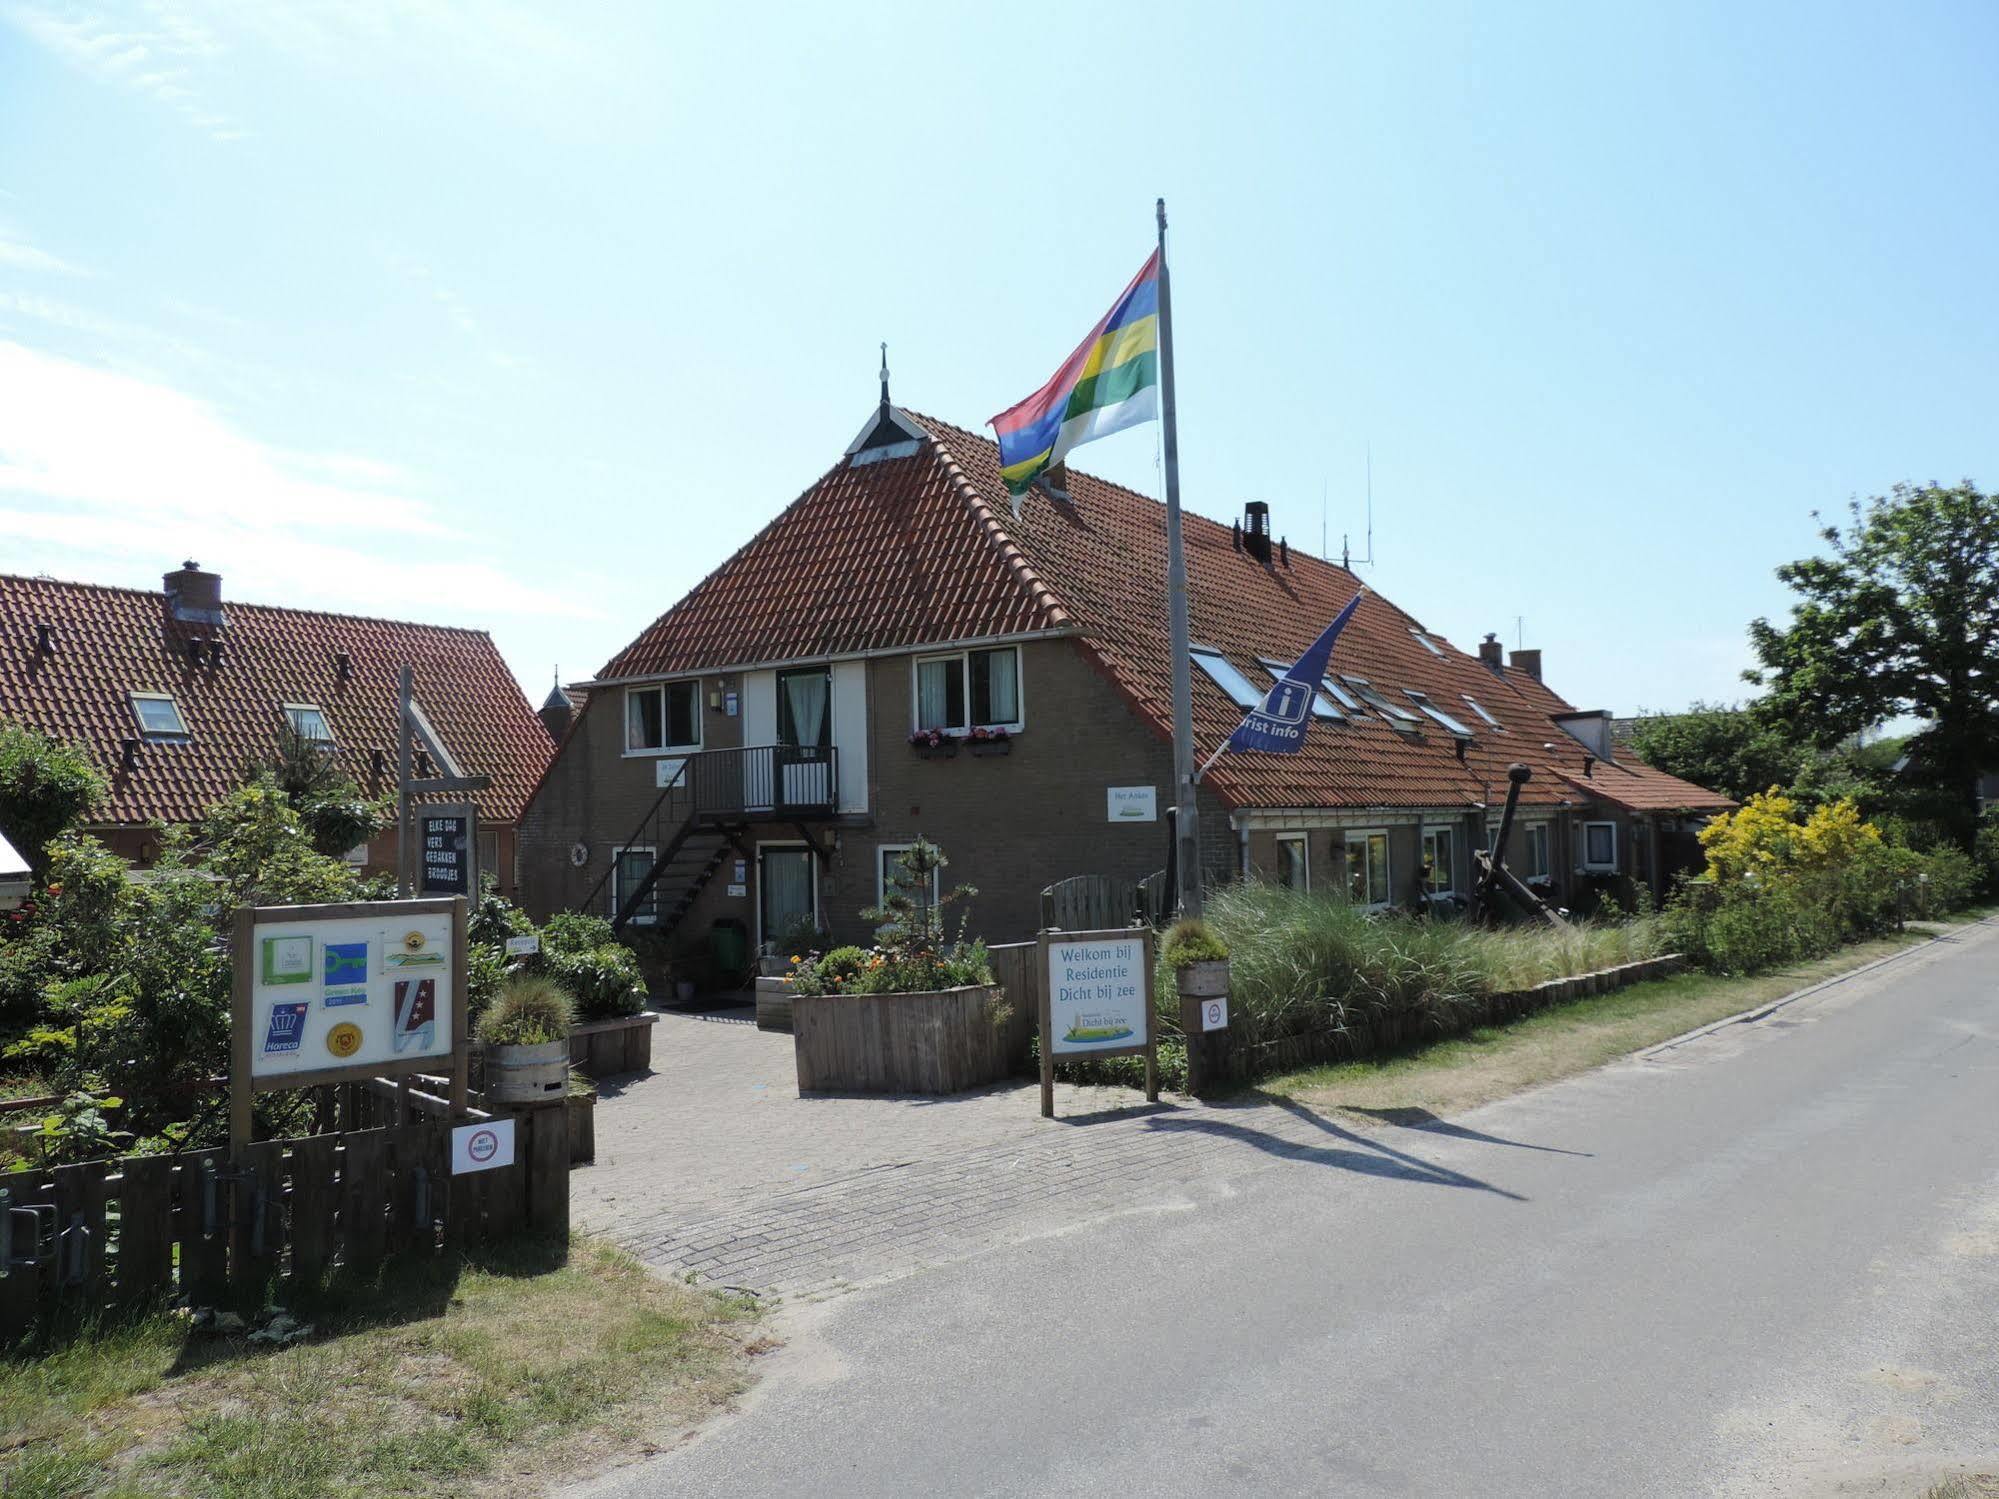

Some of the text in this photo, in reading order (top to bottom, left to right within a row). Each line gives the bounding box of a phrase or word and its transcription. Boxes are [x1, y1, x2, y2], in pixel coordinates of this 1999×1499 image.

[1270, 723, 1299, 739] info
[428, 819, 457, 832] ELKE DAG
[427, 836, 442, 849] VERS
[425, 851, 457, 864] GEBAKKEN
[428, 867, 458, 881] BROODJES
[1061, 945, 1132, 962] Welkom bij
[1066, 965, 1128, 981] Residentie
[1060, 984, 1135, 1001] Dicht bij zee
[1082, 1018, 1102, 1027] Dicht
[266, 1041, 299, 1051] Horeca
